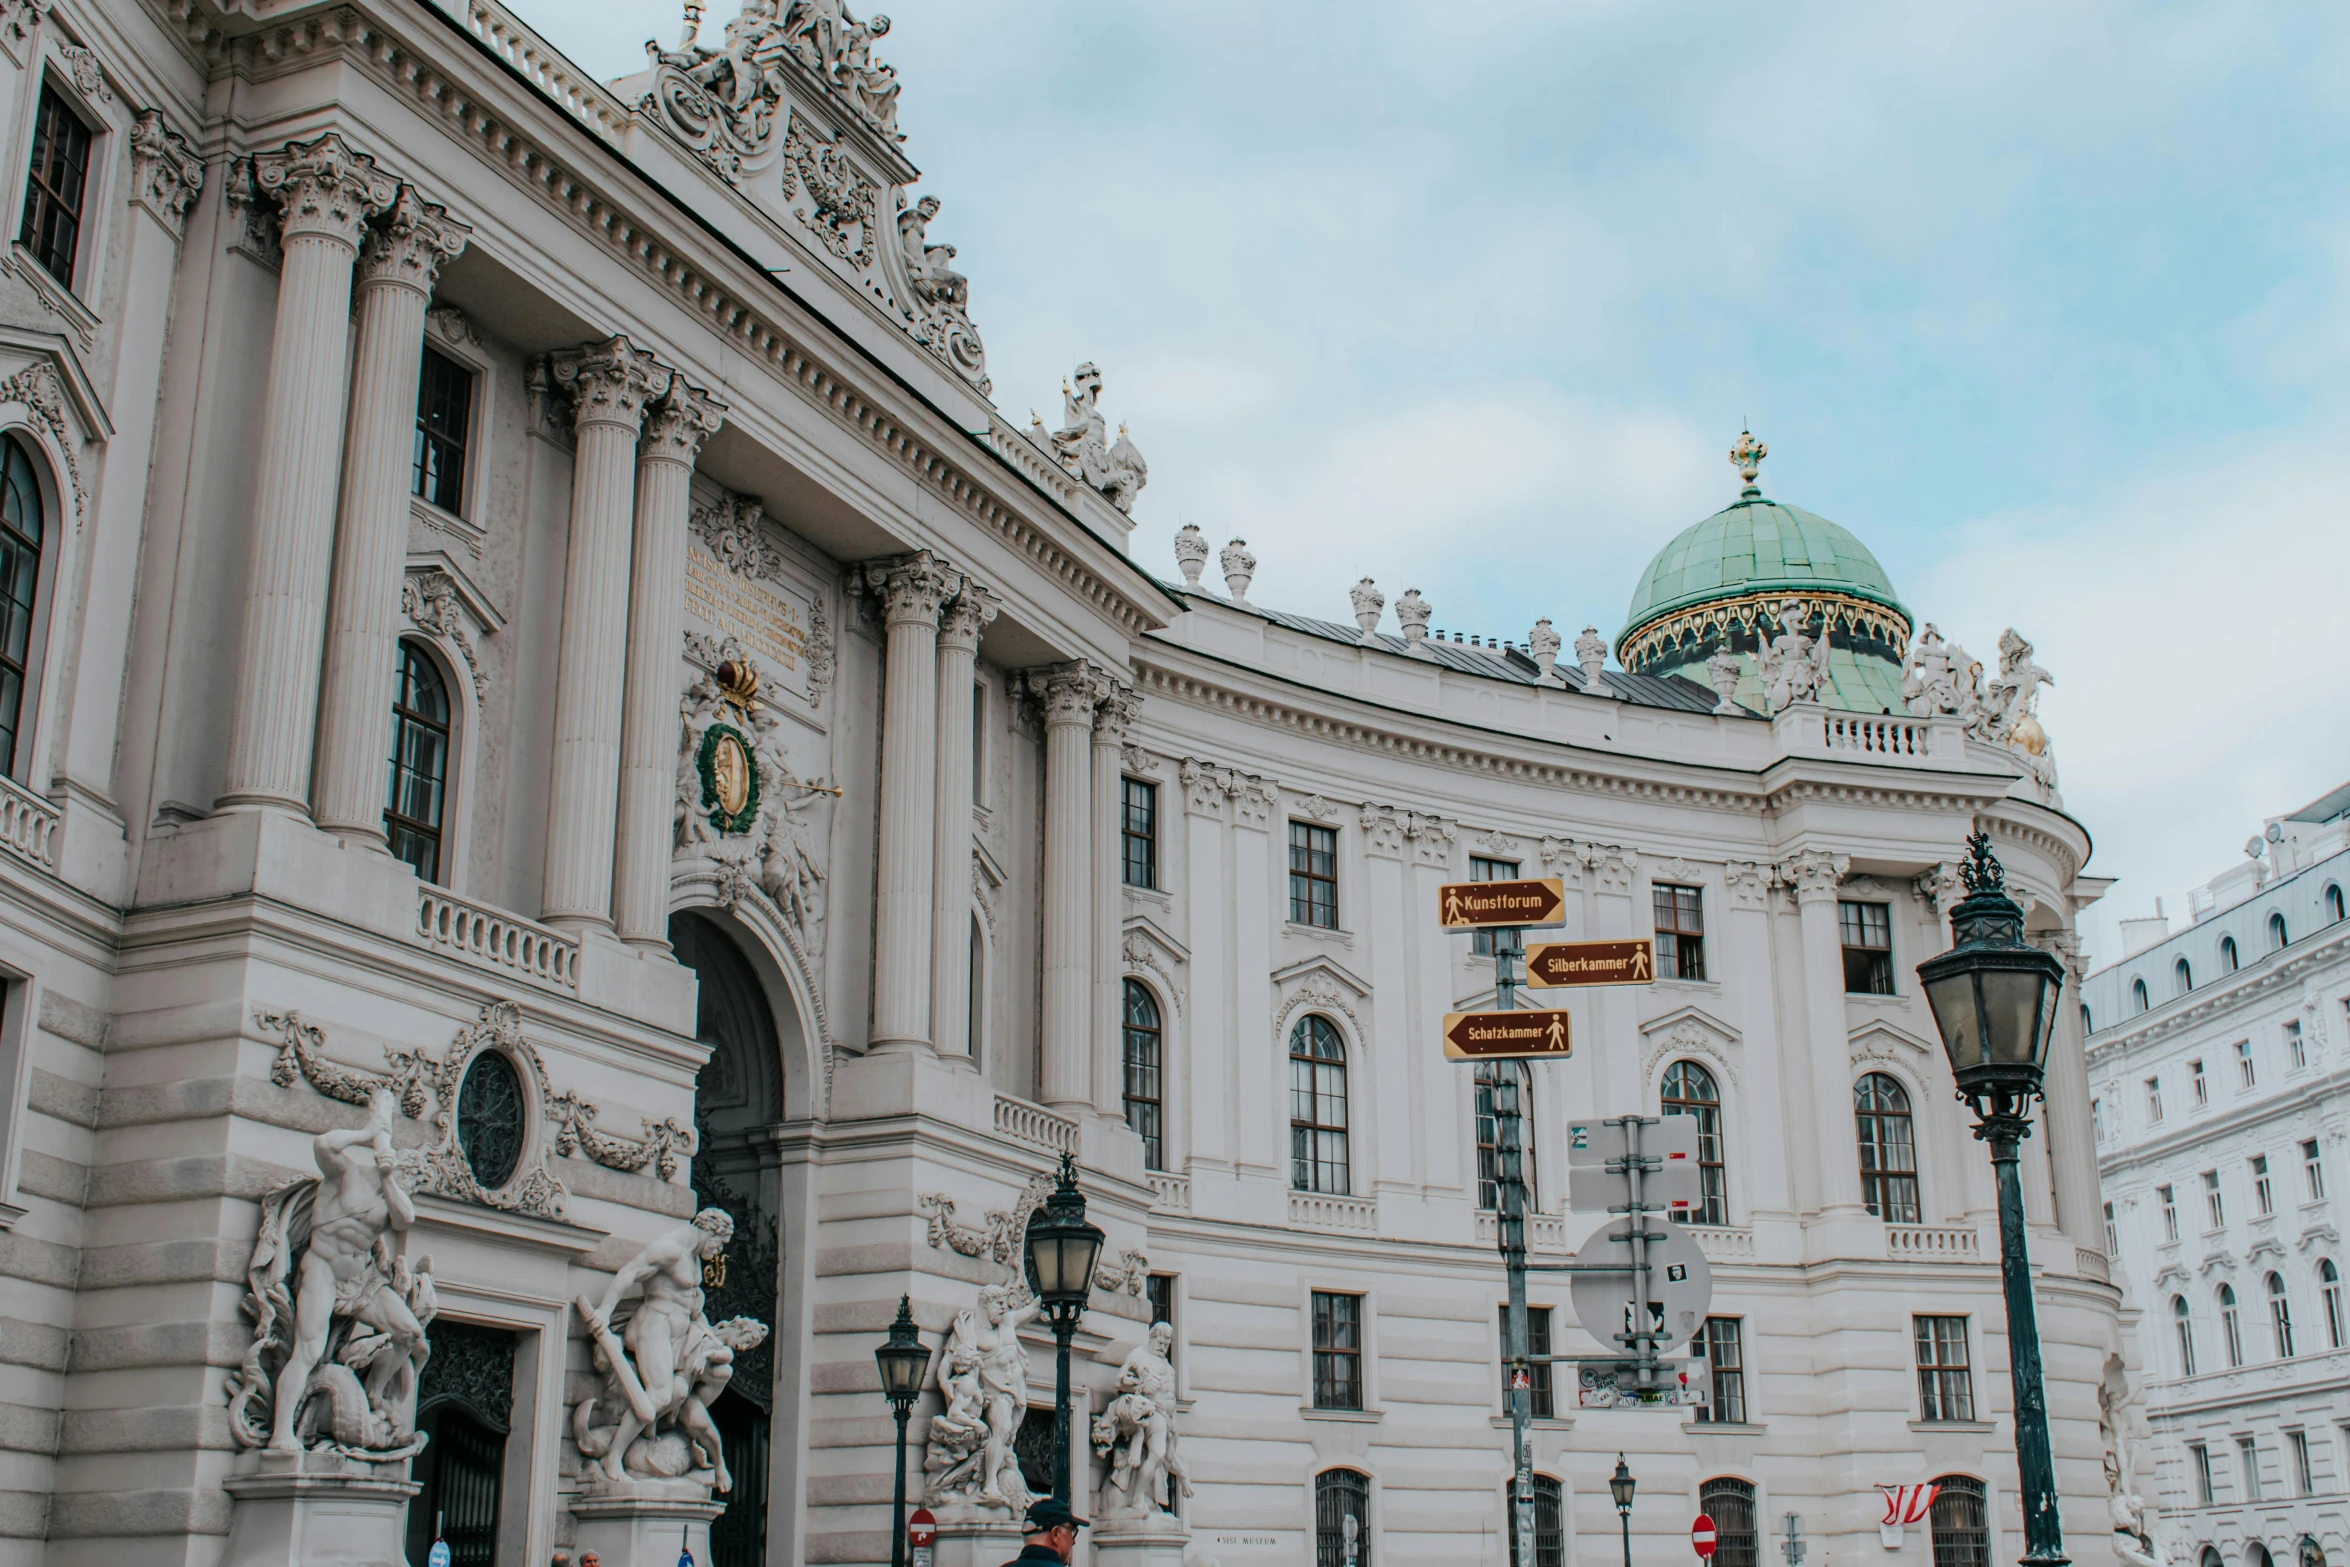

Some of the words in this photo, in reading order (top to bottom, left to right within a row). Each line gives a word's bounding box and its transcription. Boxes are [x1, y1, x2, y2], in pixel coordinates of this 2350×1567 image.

[738, 575, 787, 616] IOSEPHVS
[1464, 894, 1542, 911] Kunstforum
[1548, 957, 1628, 973] Silberkammer
[1468, 1026, 1544, 1040] Schatzkammer
